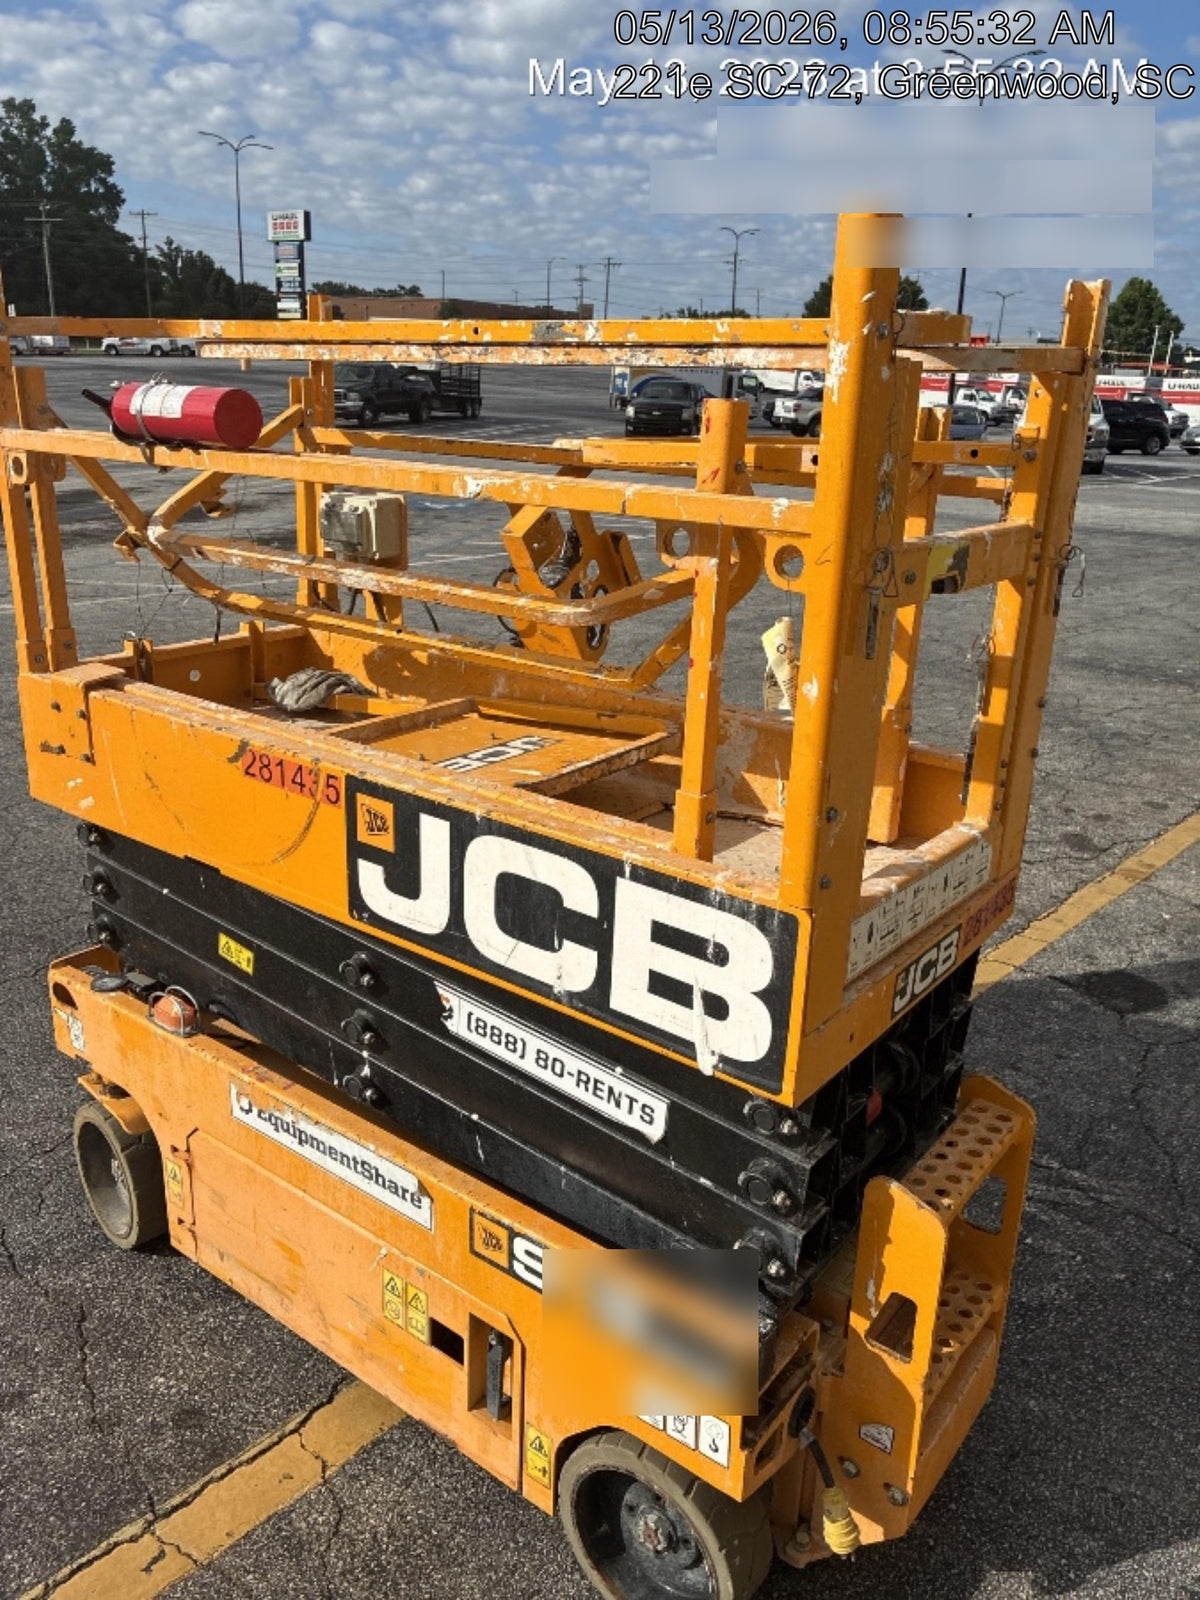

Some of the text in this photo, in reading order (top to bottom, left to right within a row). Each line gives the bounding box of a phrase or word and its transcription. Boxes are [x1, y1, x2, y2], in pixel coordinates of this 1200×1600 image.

[356, 811, 774, 1065] JCB
[893, 930, 960, 1013] JCB
[466, 1010, 656, 1126] (888) 80-RENTS
[257, 1108, 422, 1210] EquipmentShare
